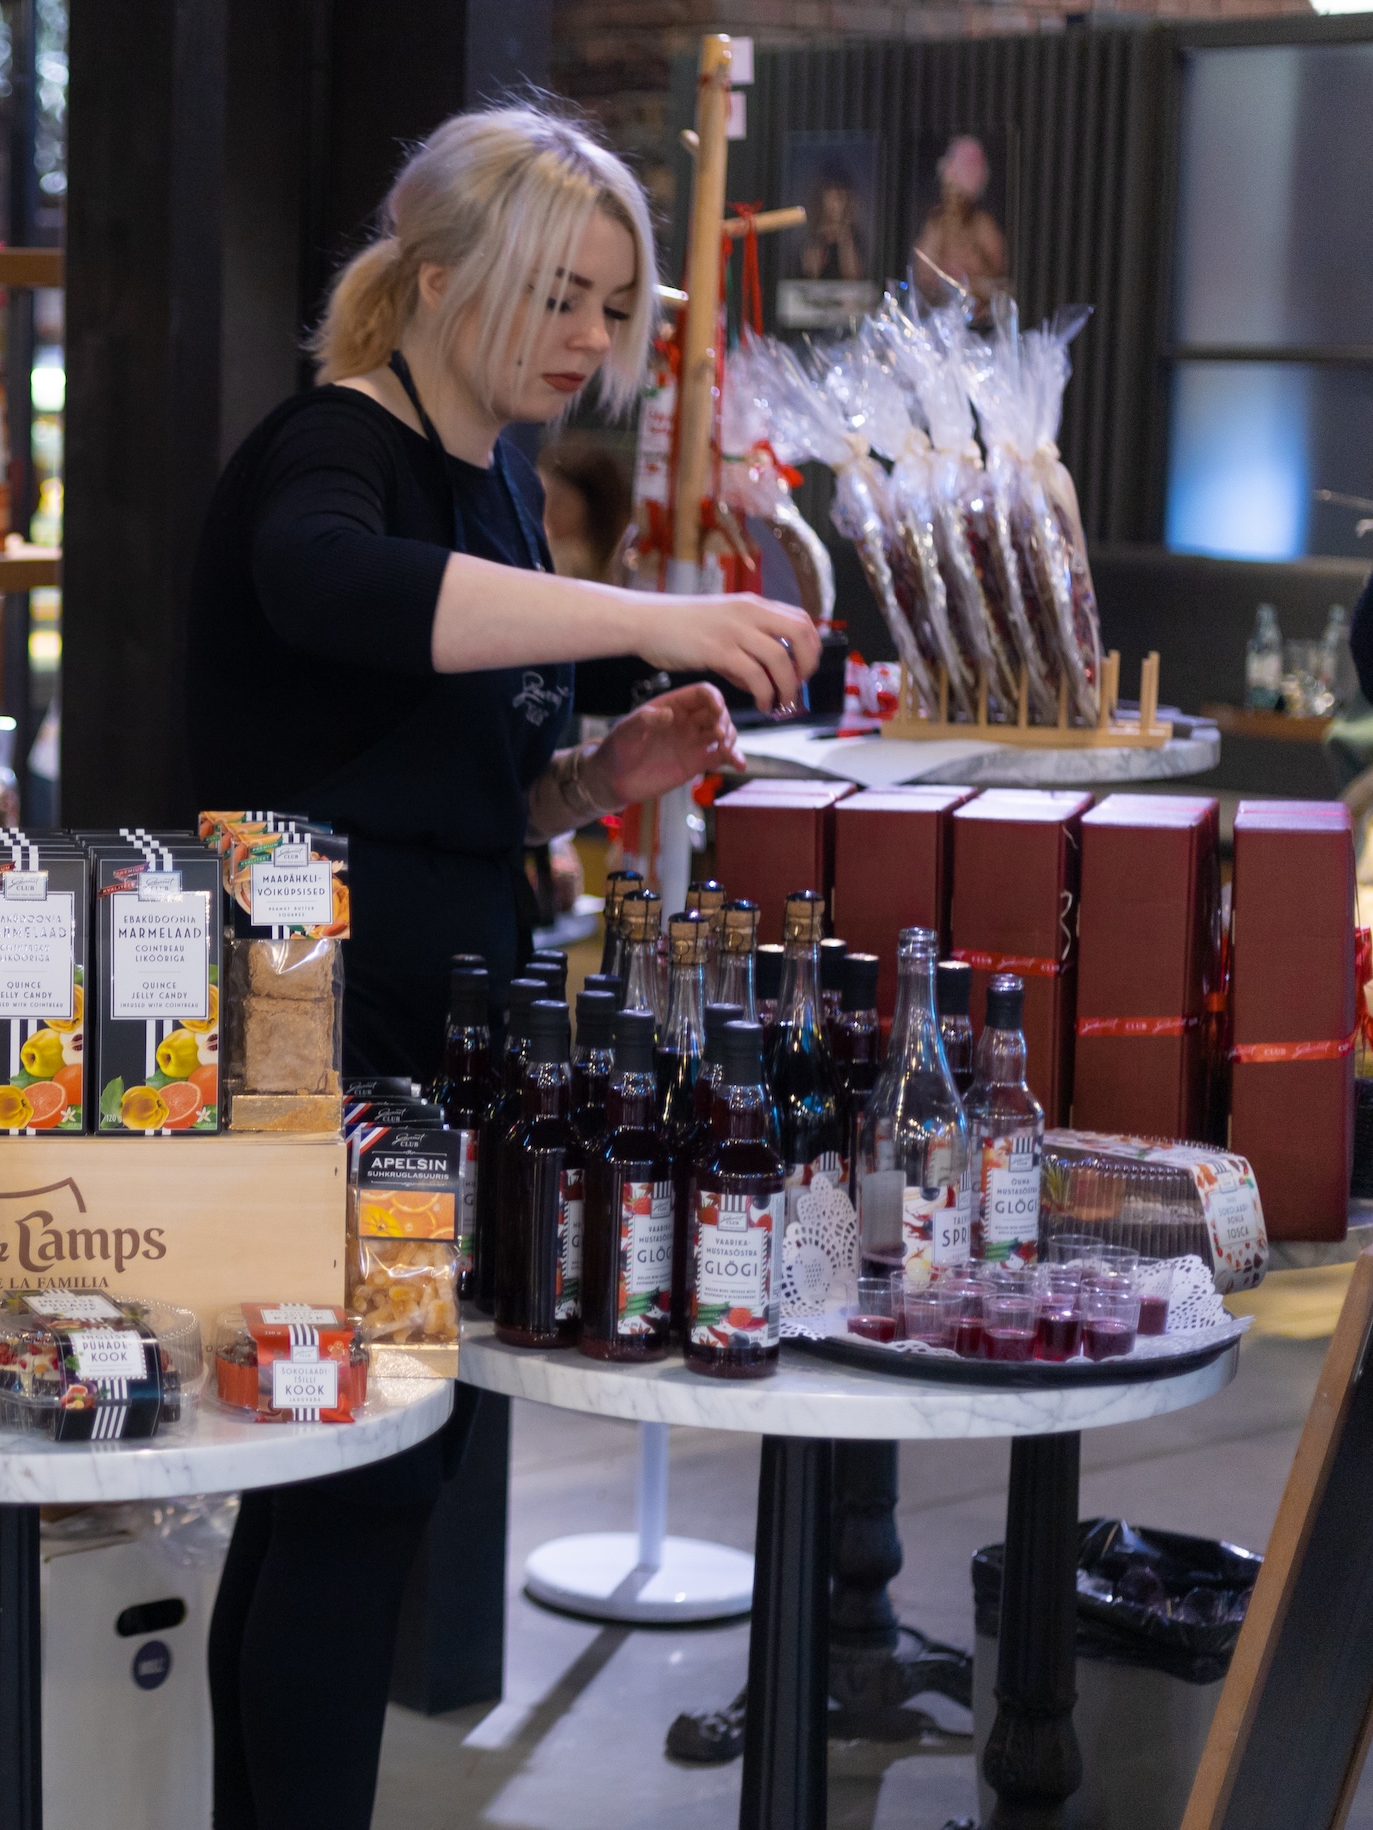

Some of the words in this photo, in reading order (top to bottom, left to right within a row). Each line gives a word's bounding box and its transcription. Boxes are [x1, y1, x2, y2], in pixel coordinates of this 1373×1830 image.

[253, 842, 278, 853] PREMIUM
[241, 855, 270, 867] KVALITEET
[114, 865, 145, 877] PREMIUM
[8, 877, 40, 889] Gourmet
[262, 874, 322, 884] MAAPÄHKLI-
[102, 882, 136, 894] KVALITEET
[257, 887, 326, 897] VÕIKÜPSISED
[123, 913, 196, 924] EBAKÜDOONIA
[118, 927, 202, 939] MARMELAAD
[971, 954, 992, 966] CLUB
[6, 981, 41, 989] QUINCE
[142, 981, 177, 989] QUINCE
[1125, 1022, 1147, 1031] CLUB
[1264, 1047, 1286, 1056] CLUB
[105, 1113, 116, 1123] 120
[391, 1132, 426, 1146] Gourmet
[370, 1157, 448, 1171] APELSIN
[367, 1171, 450, 1180] SUHKRUGLASUURIS
[995, 1199, 1038, 1214] GLÖGI
[1227, 1226, 1250, 1239] TOSCA
[715, 1238, 751, 1247] VAARIKA-
[636, 1246, 671, 1263] GLÖG
[704, 1260, 758, 1277] GLÖGI
[9, 1278, 31, 1289] LA
[37, 1276, 110, 1289] FAMILIA
[81, 1333, 129, 1341] INGLISE
[82, 1341, 132, 1351] PÜHADE-
[91, 1352, 128, 1363] KOOK
[280, 1366, 331, 1375] ŠOKOLAADI-
[294, 1375, 316, 1383] TŠILLI
[285, 1385, 325, 1396] KOOK
